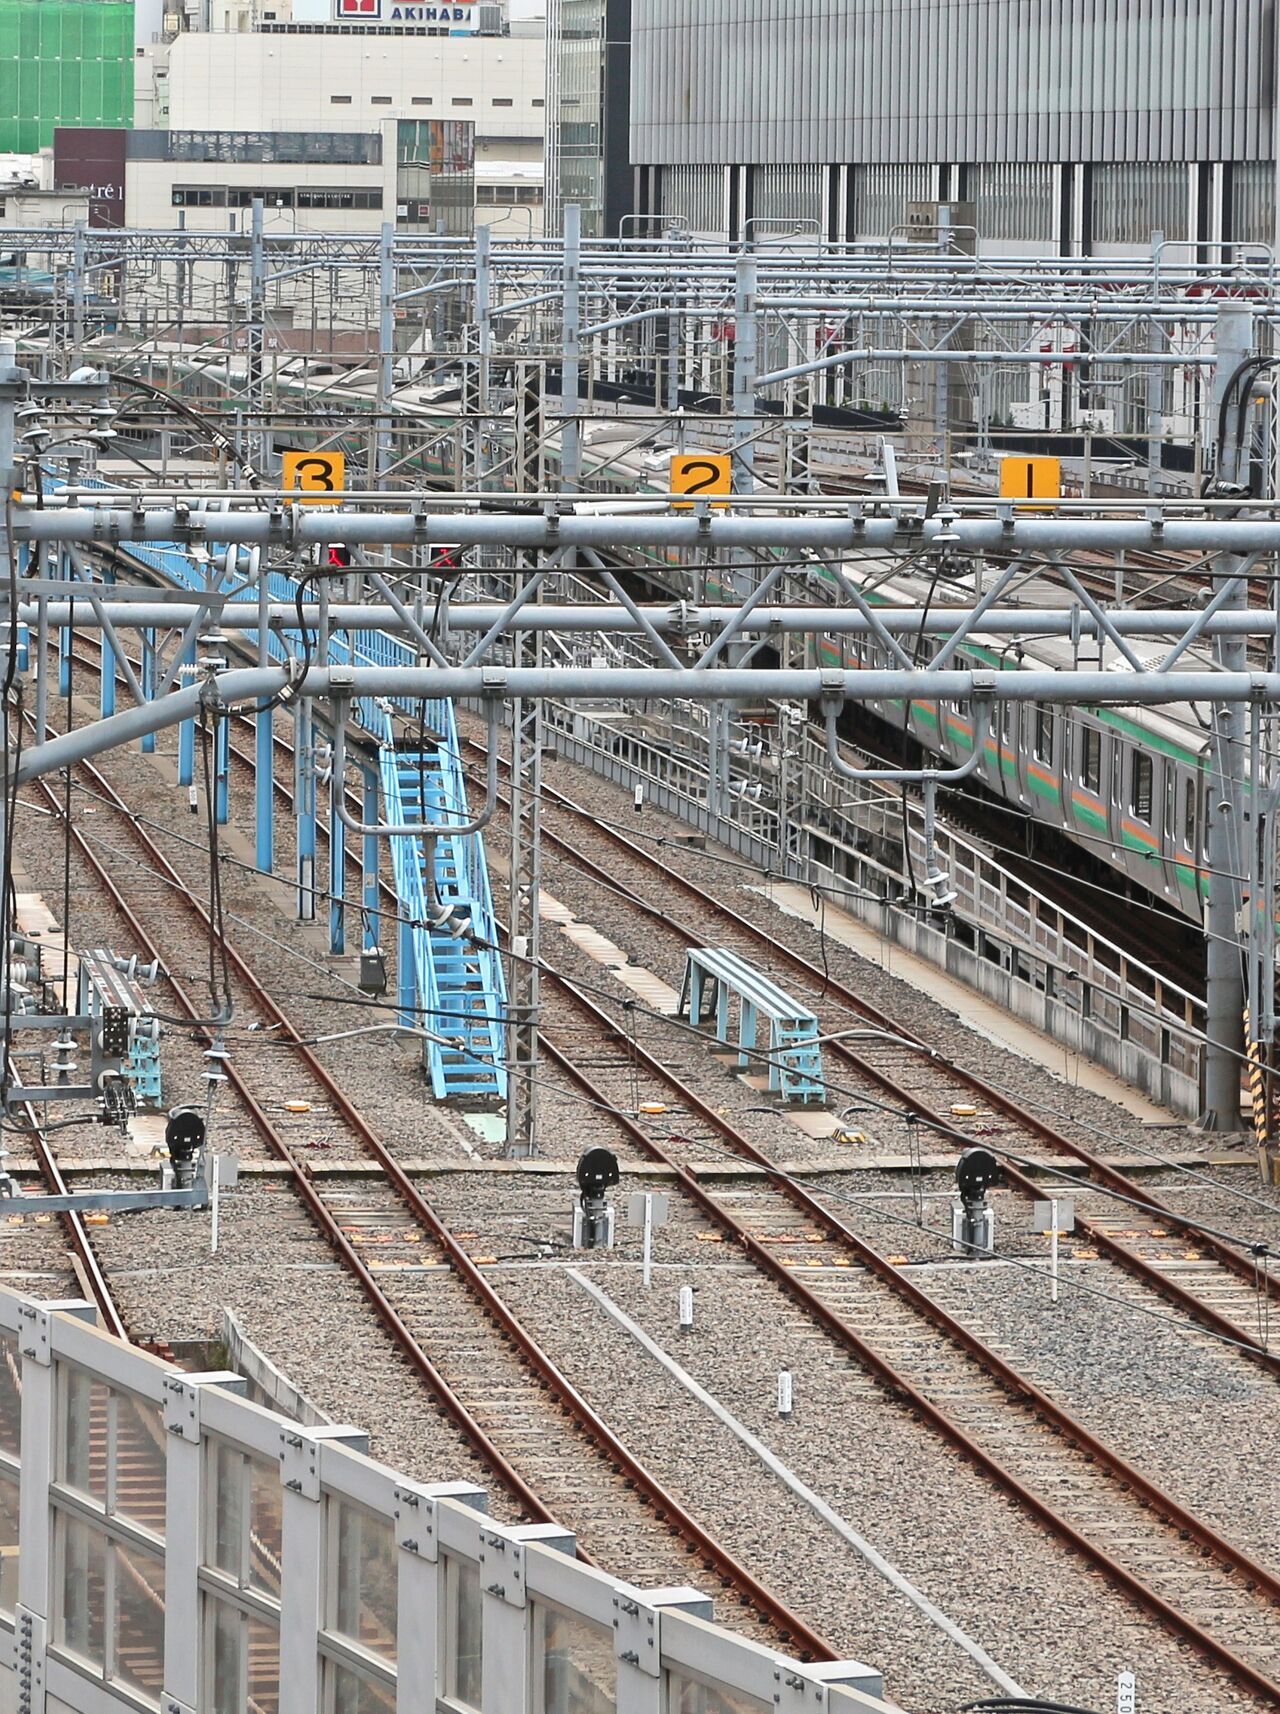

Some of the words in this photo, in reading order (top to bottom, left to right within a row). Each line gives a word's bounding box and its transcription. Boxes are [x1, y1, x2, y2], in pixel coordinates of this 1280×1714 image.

[295, 458, 333, 491] 3
[681, 461, 720, 495] 2
[1027, 463, 1033, 498] 1
